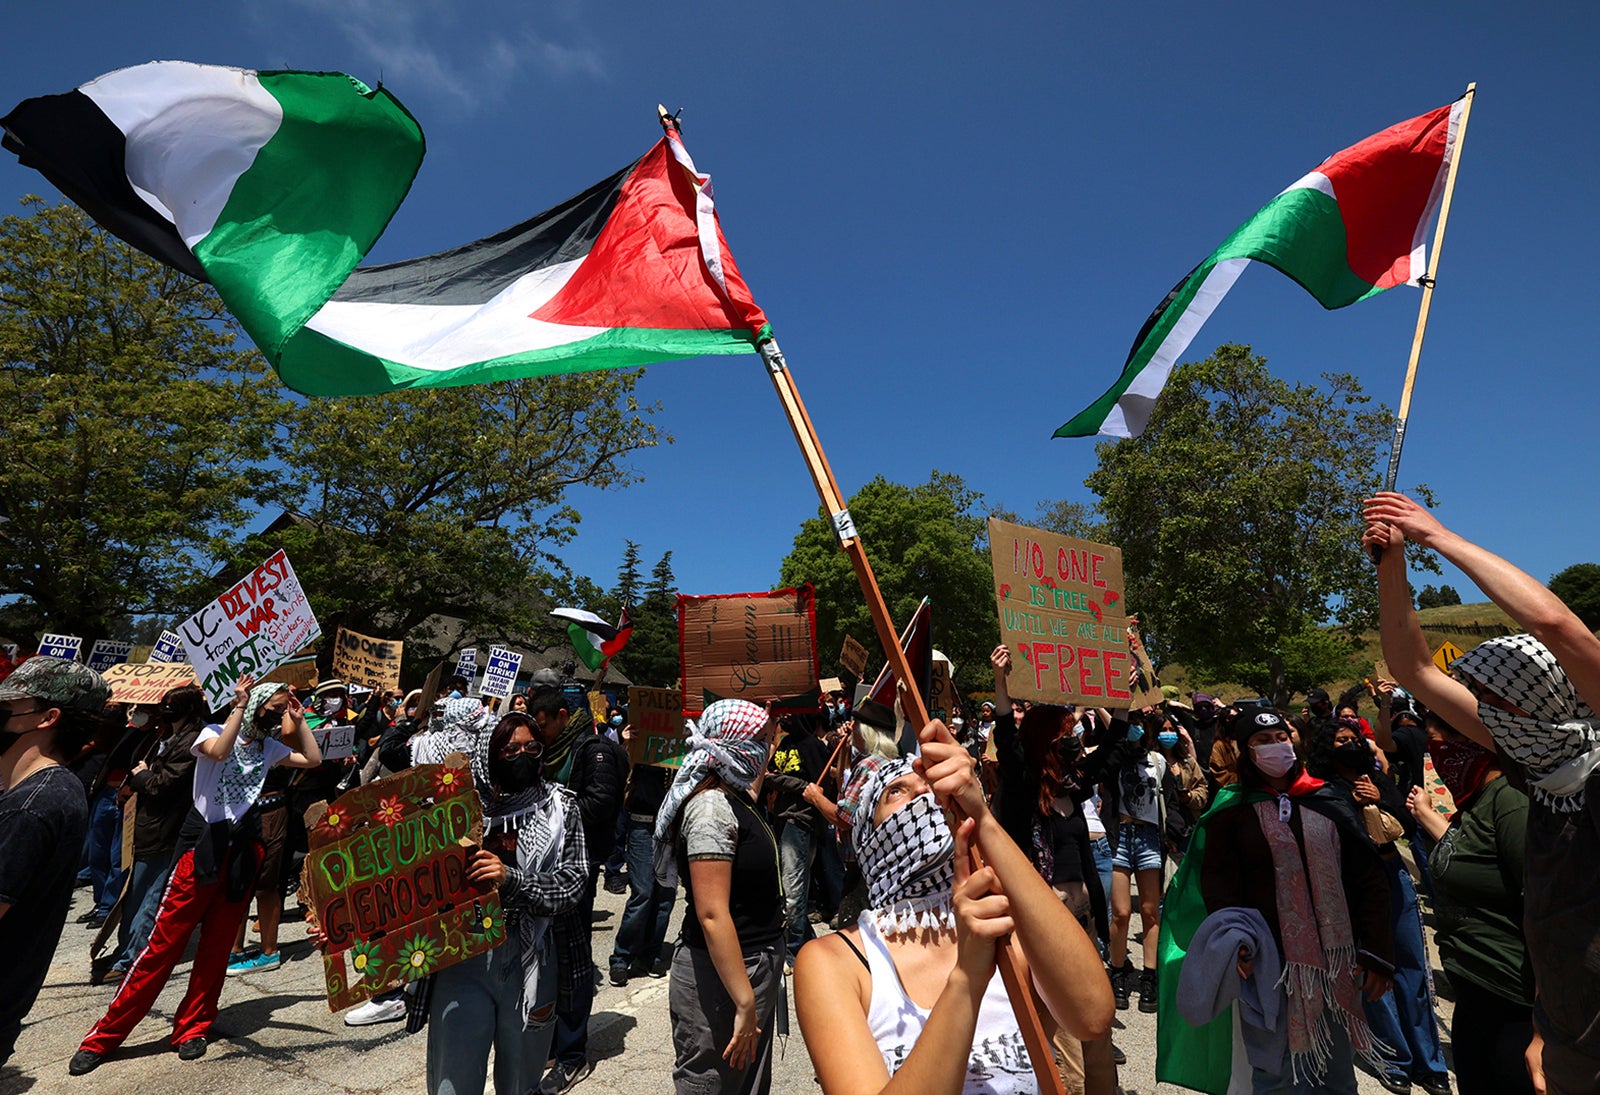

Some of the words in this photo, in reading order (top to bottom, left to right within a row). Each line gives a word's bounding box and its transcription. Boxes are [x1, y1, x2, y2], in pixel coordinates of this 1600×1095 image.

[1013, 538, 1045, 580] NO
[1057, 546, 1107, 589] ONE
[217, 550, 289, 620] DIVEST
[1028, 583, 1046, 607] IS
[1053, 588, 1090, 612] FREE
[205, 636, 235, 662] from
[235, 597, 280, 639] WAR
[275, 615, 304, 647] Workers
[1003, 607, 1047, 636] UNTIL
[1050, 618, 1069, 638] WE
[1076, 623, 1099, 640] ARE
[1103, 624, 1124, 644] ALL
[44, 635, 80, 648] UAW
[161, 632, 181, 645] UAW
[338, 629, 360, 650] NO
[361, 638, 397, 660] ONE
[50, 647, 66, 657] ON
[96, 644, 131, 655] UAW
[258, 645, 272, 659] in
[729, 602, 762, 694] Crown
[102, 655, 117, 663] ON
[493, 649, 521, 662] UAW
[90, 661, 113, 670] STRI
[112, 664, 165, 677] STOP
[166, 666, 195, 678] THE
[386, 661, 398, 670] to
[458, 662, 477, 670] UAW
[498, 660, 510, 669] ON
[1031, 640, 1132, 700] FREE
[487, 666, 516, 679] STRIKE
[487, 681, 508, 690] LABOR
[488, 675, 510, 686] UNFAIR
[112, 687, 166, 702] MACHIN
[481, 685, 510, 697] PRACTICE
[637, 691, 681, 711] PALES
[640, 711, 675, 733] WILL
[320, 801, 471, 892] DEFUND
[325, 854, 464, 945] GENOCID
